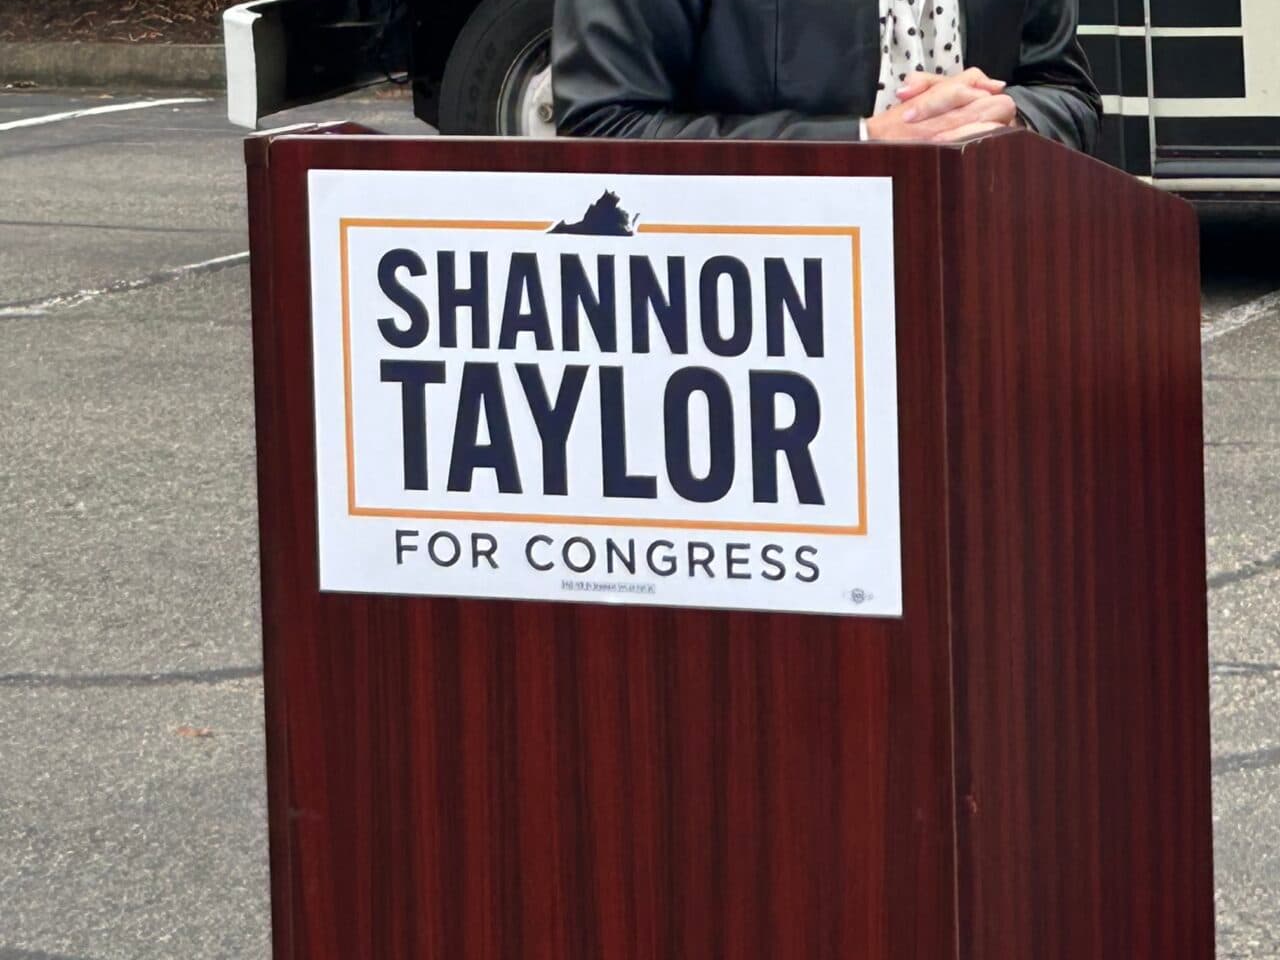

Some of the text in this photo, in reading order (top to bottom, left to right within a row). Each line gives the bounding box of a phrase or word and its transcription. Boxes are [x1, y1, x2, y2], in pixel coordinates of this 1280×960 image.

[376, 248, 824, 359] SHANNON
[380, 358, 826, 506] TAYLOR
[395, 529, 821, 583] FOR CONGRESS
